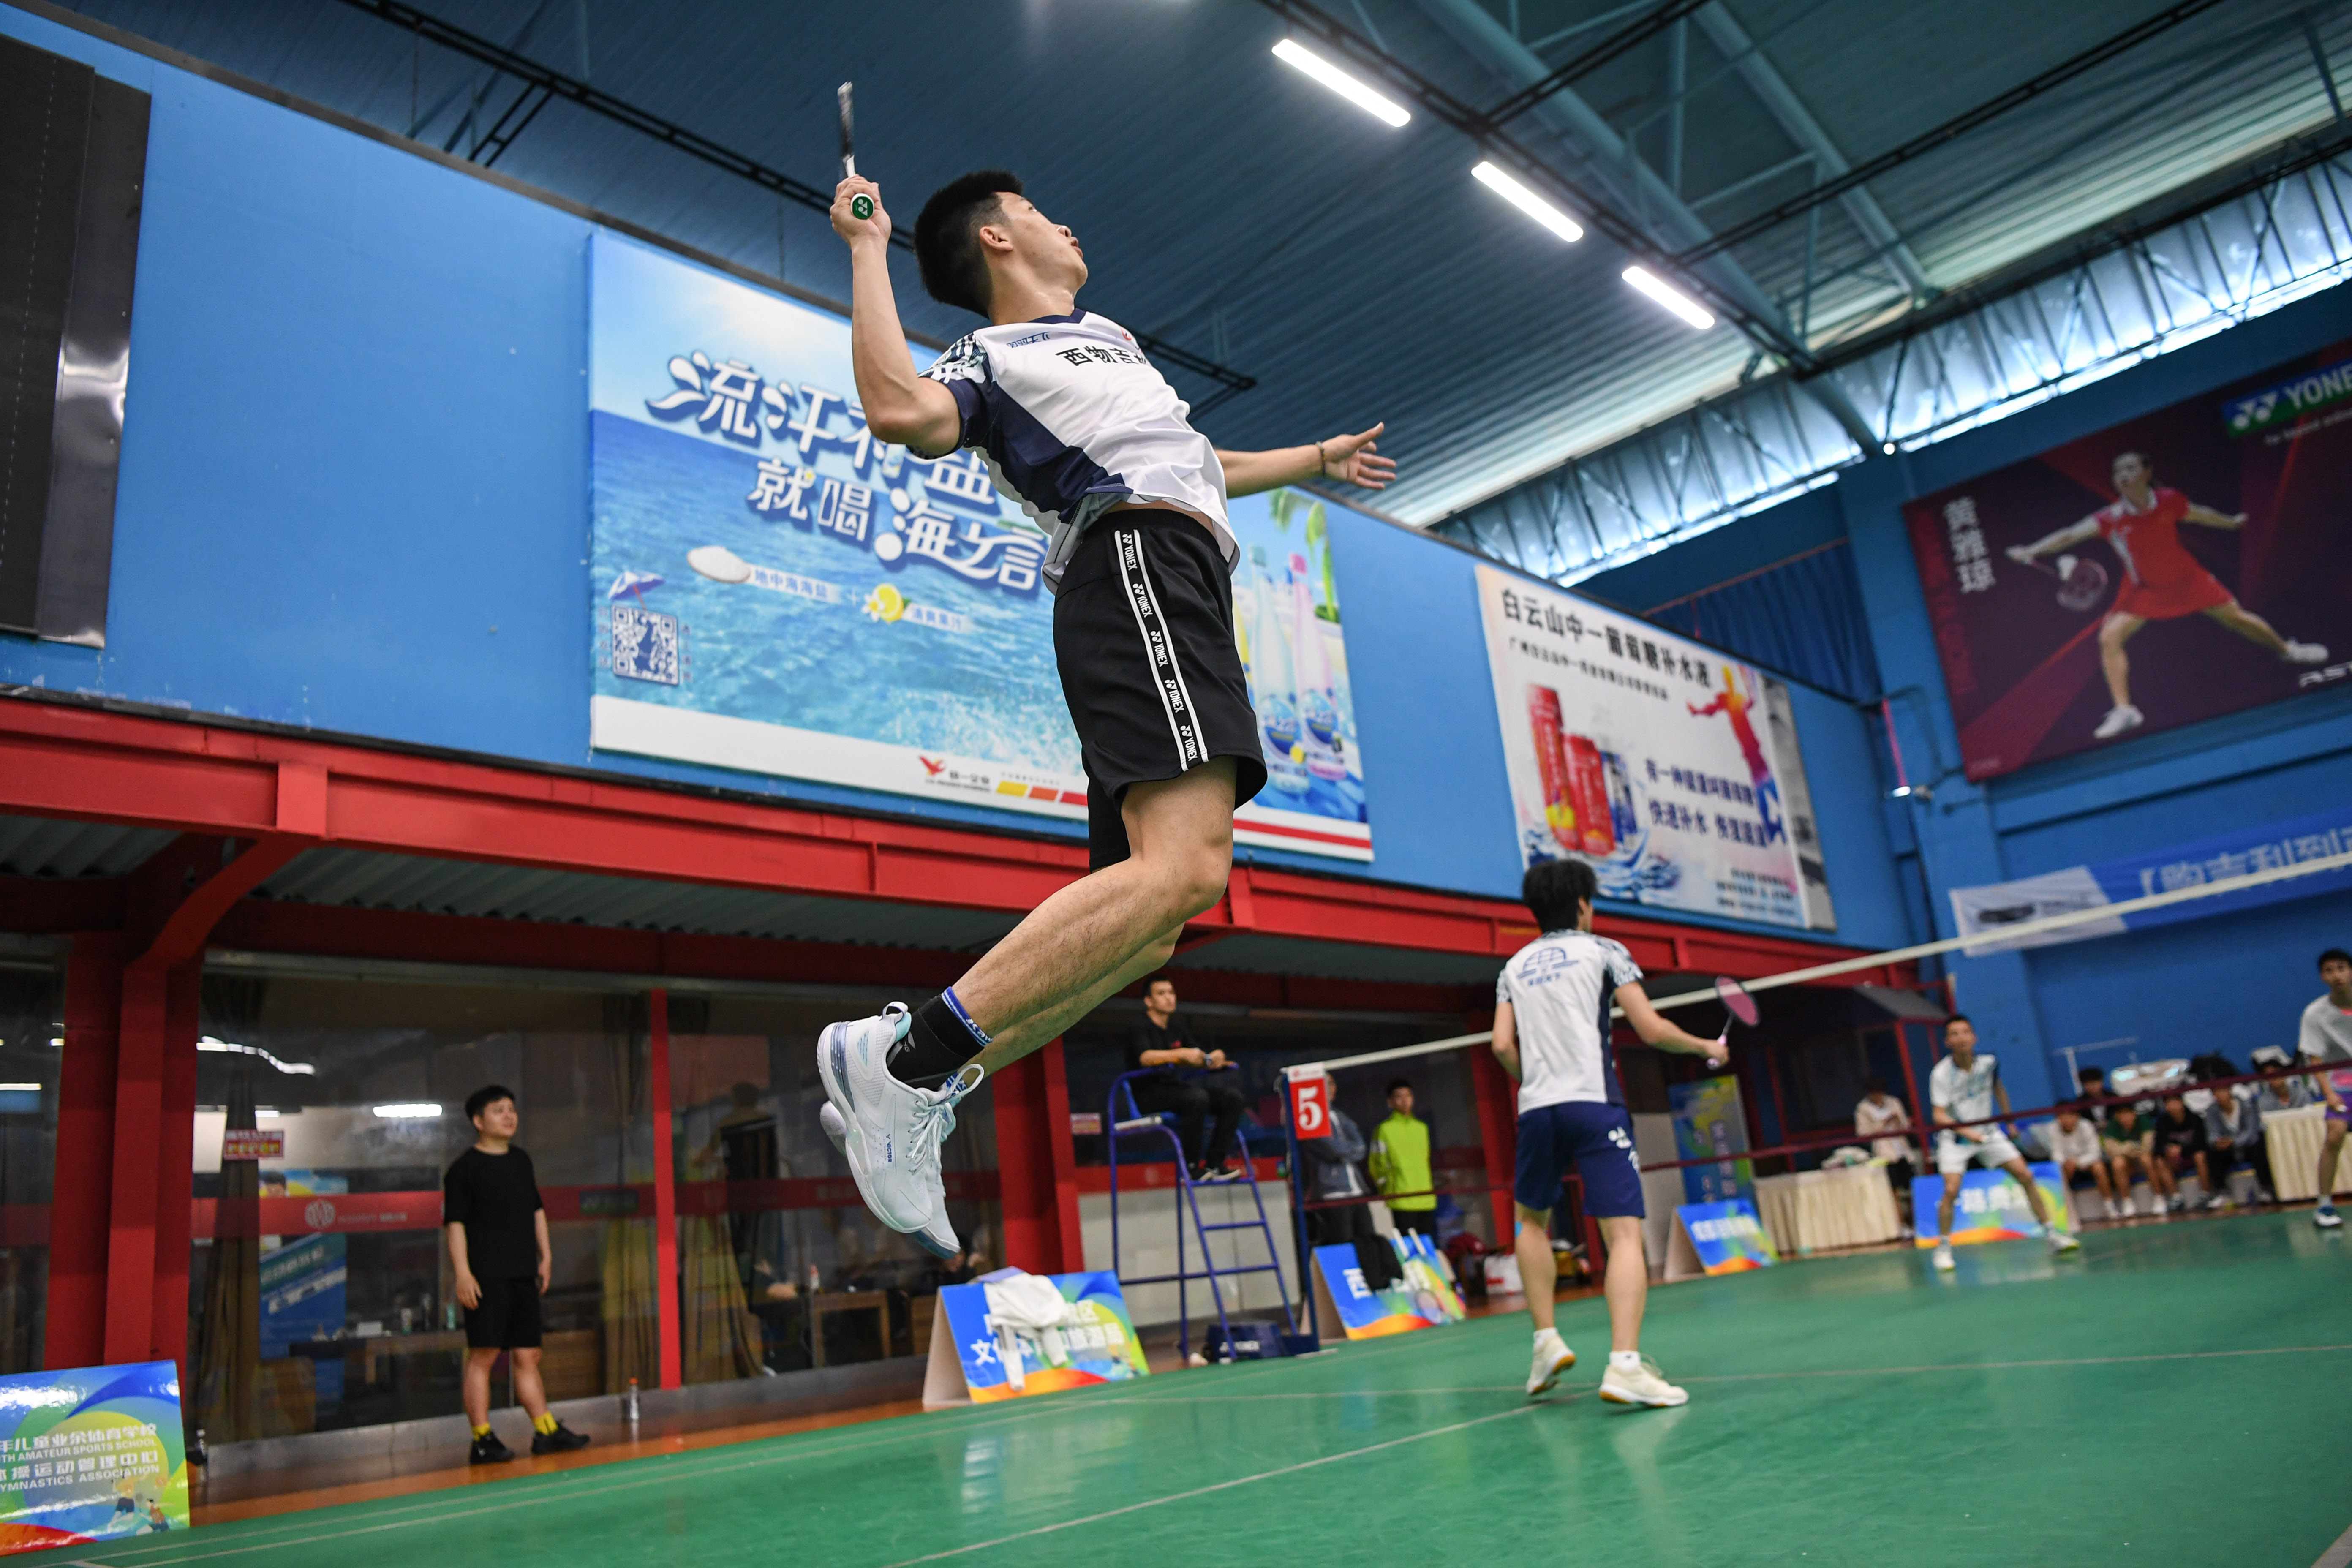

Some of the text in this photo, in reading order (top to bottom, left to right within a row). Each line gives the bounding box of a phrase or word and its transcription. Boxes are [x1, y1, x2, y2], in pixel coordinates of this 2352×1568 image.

[748, 458, 1047, 590] 就喝海之言
[1125, 545, 1137, 571] YONEX
[1137, 595, 1153, 618] YONEX
[1154, 643, 1168, 667] YONEX
[1169, 689, 1184, 713] YONEX
[1184, 737, 1198, 761] YONEX
[1298, 1086, 1323, 1131] 5
[18, 1446, 71, 1462] AMATEUR
[73, 1442, 113, 1456] SPORTS
[115, 1438, 155, 1451] SCHOOL
[79, 1465, 159, 1483] ASSOCIATION
